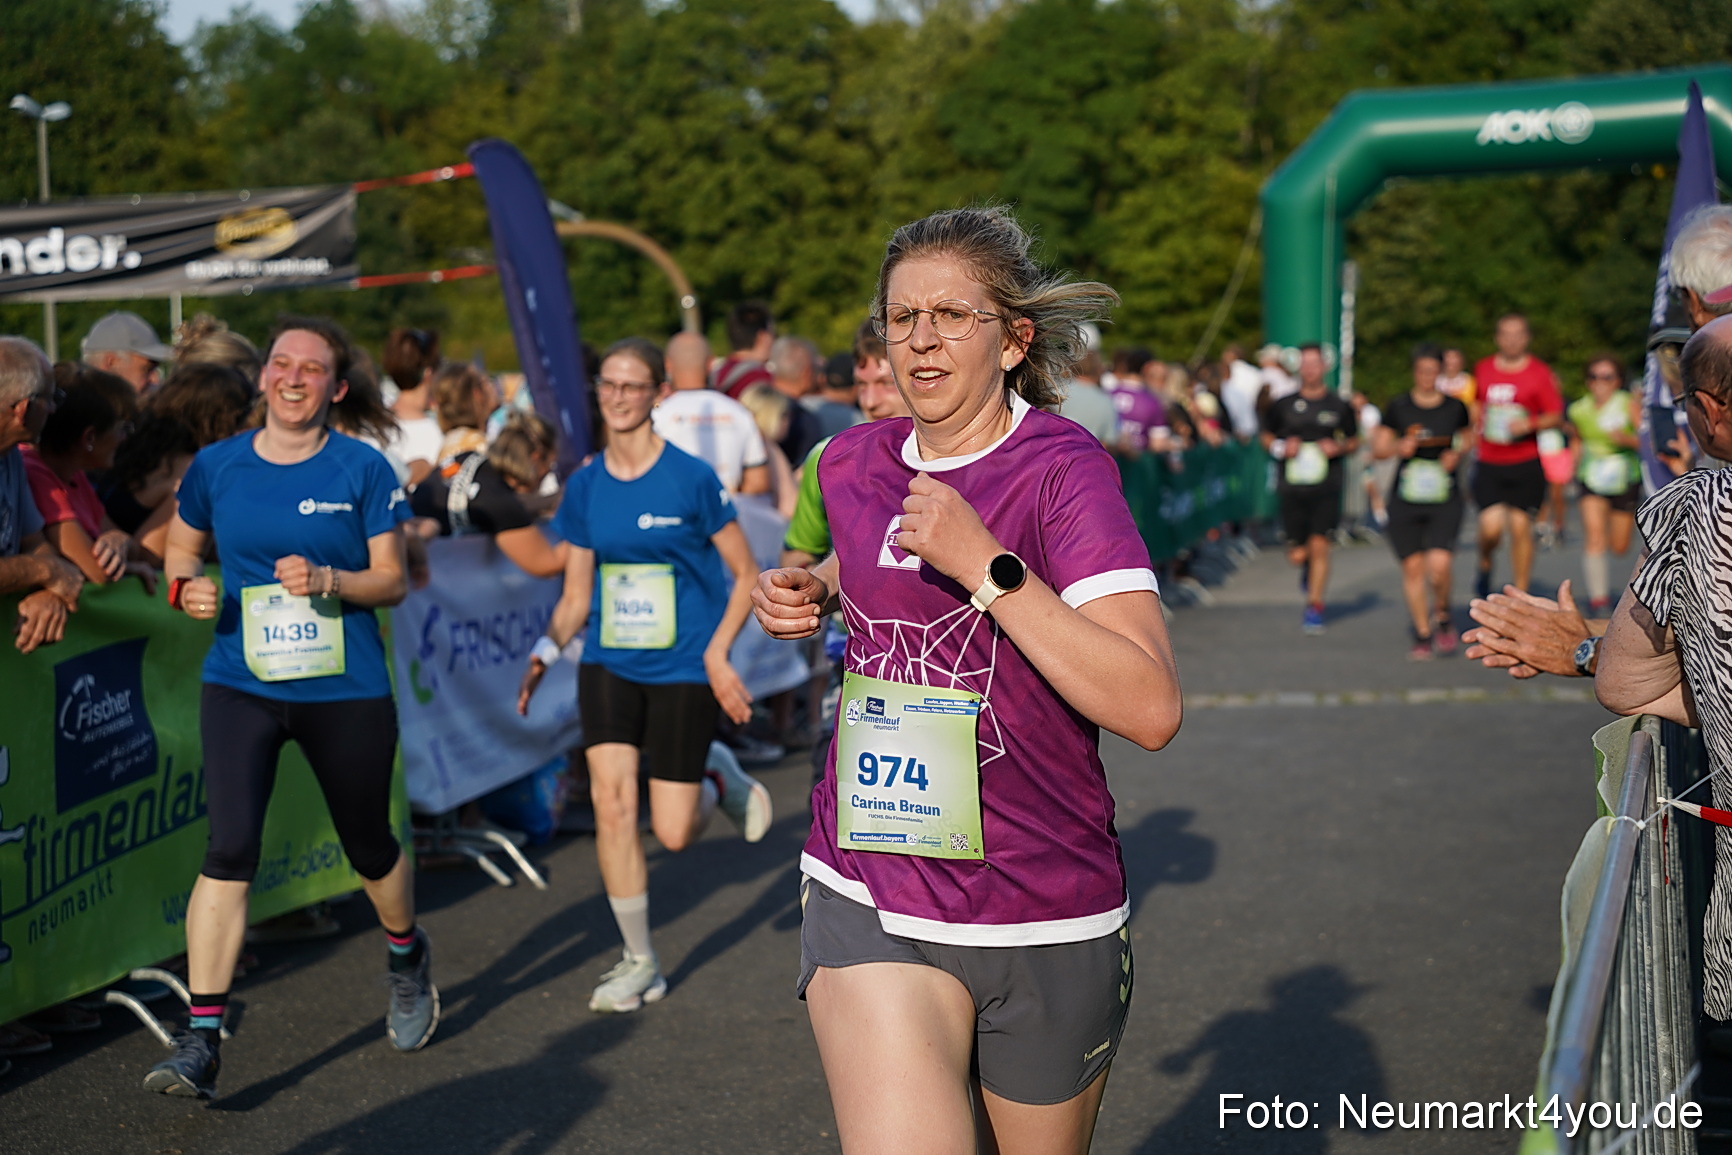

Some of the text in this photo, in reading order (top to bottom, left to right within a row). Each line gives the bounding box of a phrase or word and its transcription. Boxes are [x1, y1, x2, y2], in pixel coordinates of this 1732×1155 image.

[1476, 108, 1554, 146] AOK
[263, 622, 318, 643] 1439
[76, 688, 131, 731] Fischer
[860, 713, 901, 725] Firmenlauf
[857, 752, 929, 792] 974
[851, 794, 941, 816] Carina Braun
[852, 833, 904, 842] firmenlauf.bayern
[28, 868, 113, 945] neumarkt
